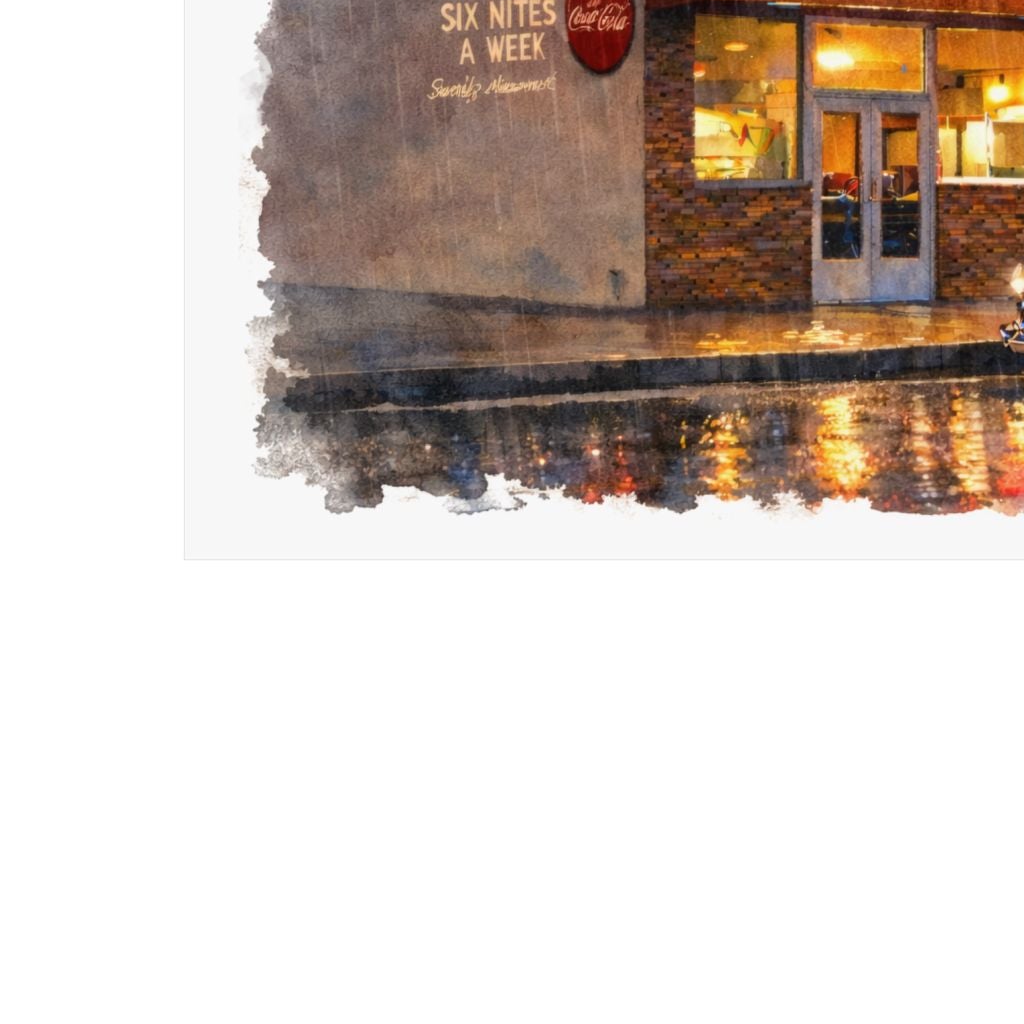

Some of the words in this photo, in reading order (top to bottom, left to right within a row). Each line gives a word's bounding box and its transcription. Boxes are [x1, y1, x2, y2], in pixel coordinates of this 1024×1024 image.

[440, 2, 479, 32] SIX
[459, 38, 475, 65] A
[486, 32, 545, 63] WEEK
